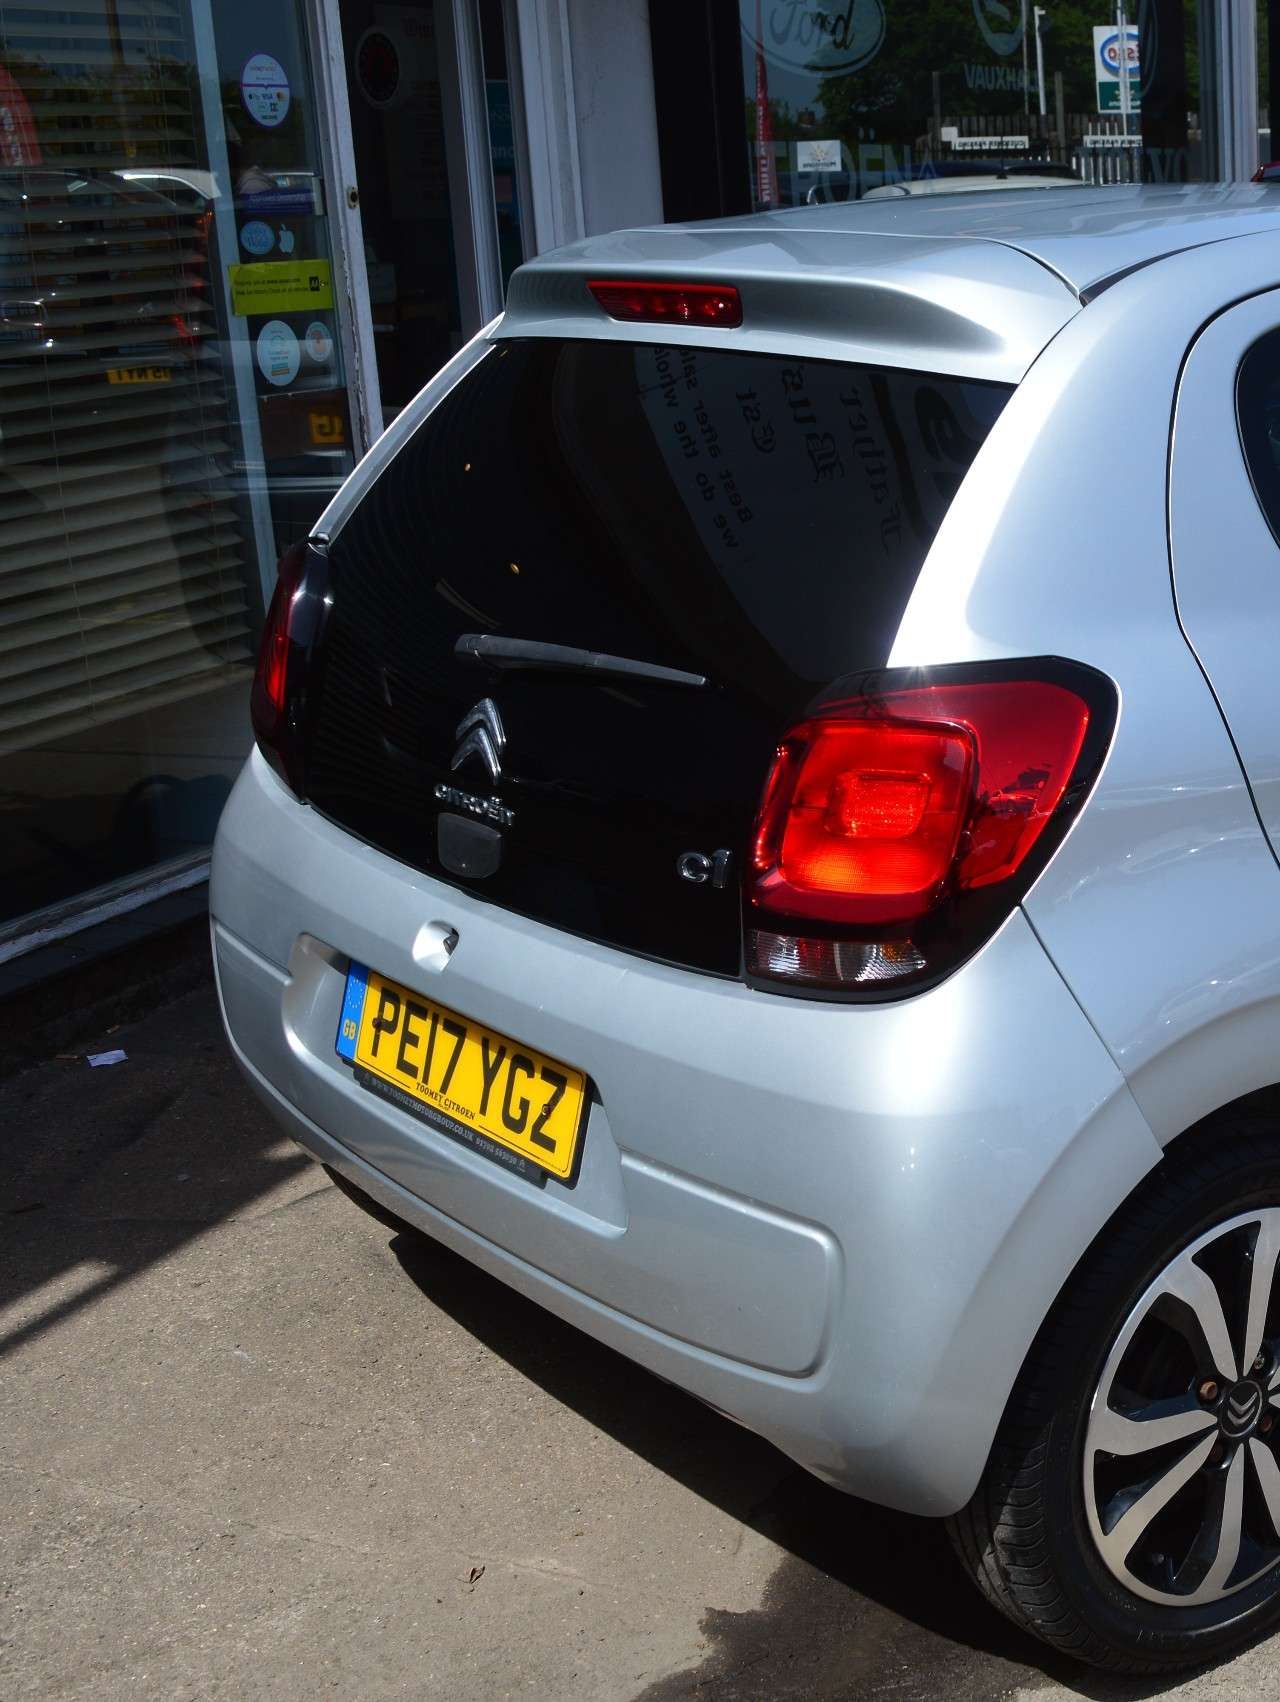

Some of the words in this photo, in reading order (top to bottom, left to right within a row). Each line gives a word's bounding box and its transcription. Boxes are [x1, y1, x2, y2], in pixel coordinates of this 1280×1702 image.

[343, 1019, 357, 1041] GB
[371, 987, 467, 1096] PE17
[478, 1036, 568, 1154] YGZ
[415, 1082, 444, 1103] TOOMEY
[443, 1098, 476, 1121] CITROEN
